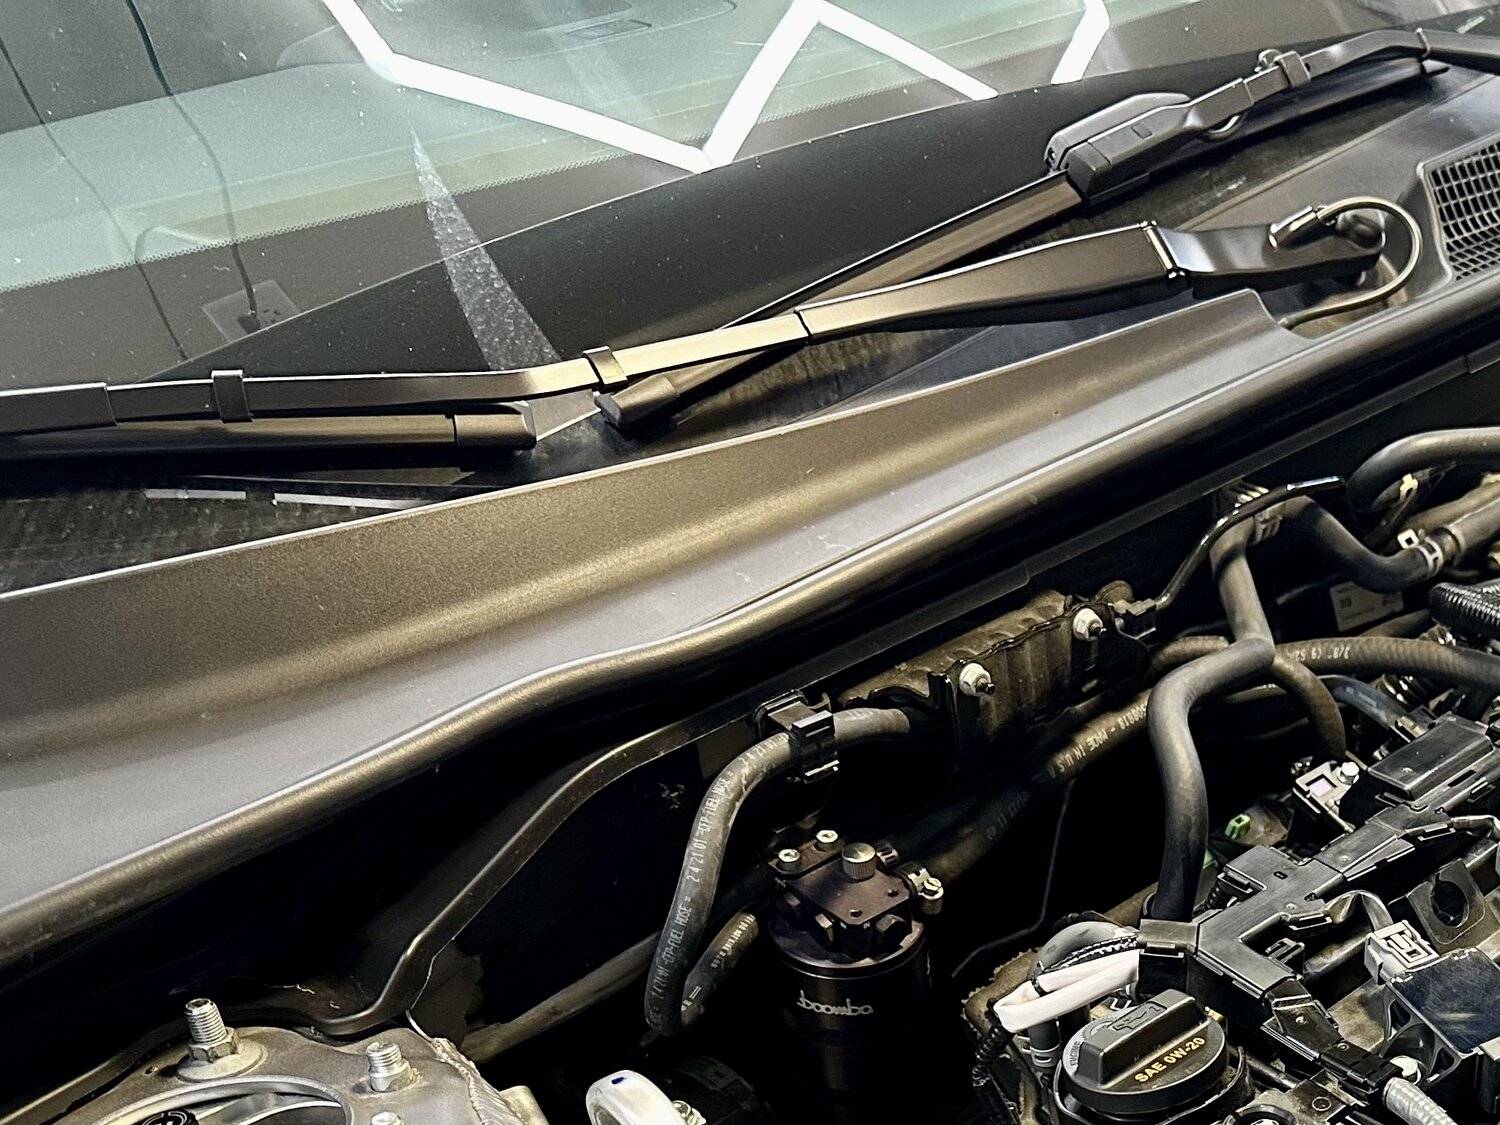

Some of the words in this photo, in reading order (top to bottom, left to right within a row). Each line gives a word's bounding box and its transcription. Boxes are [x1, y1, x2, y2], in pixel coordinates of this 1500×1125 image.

[797, 990, 874, 1015] boomba
[1134, 1060, 1168, 1082] SAE
[1163, 1037, 1206, 1064] 0W-20
